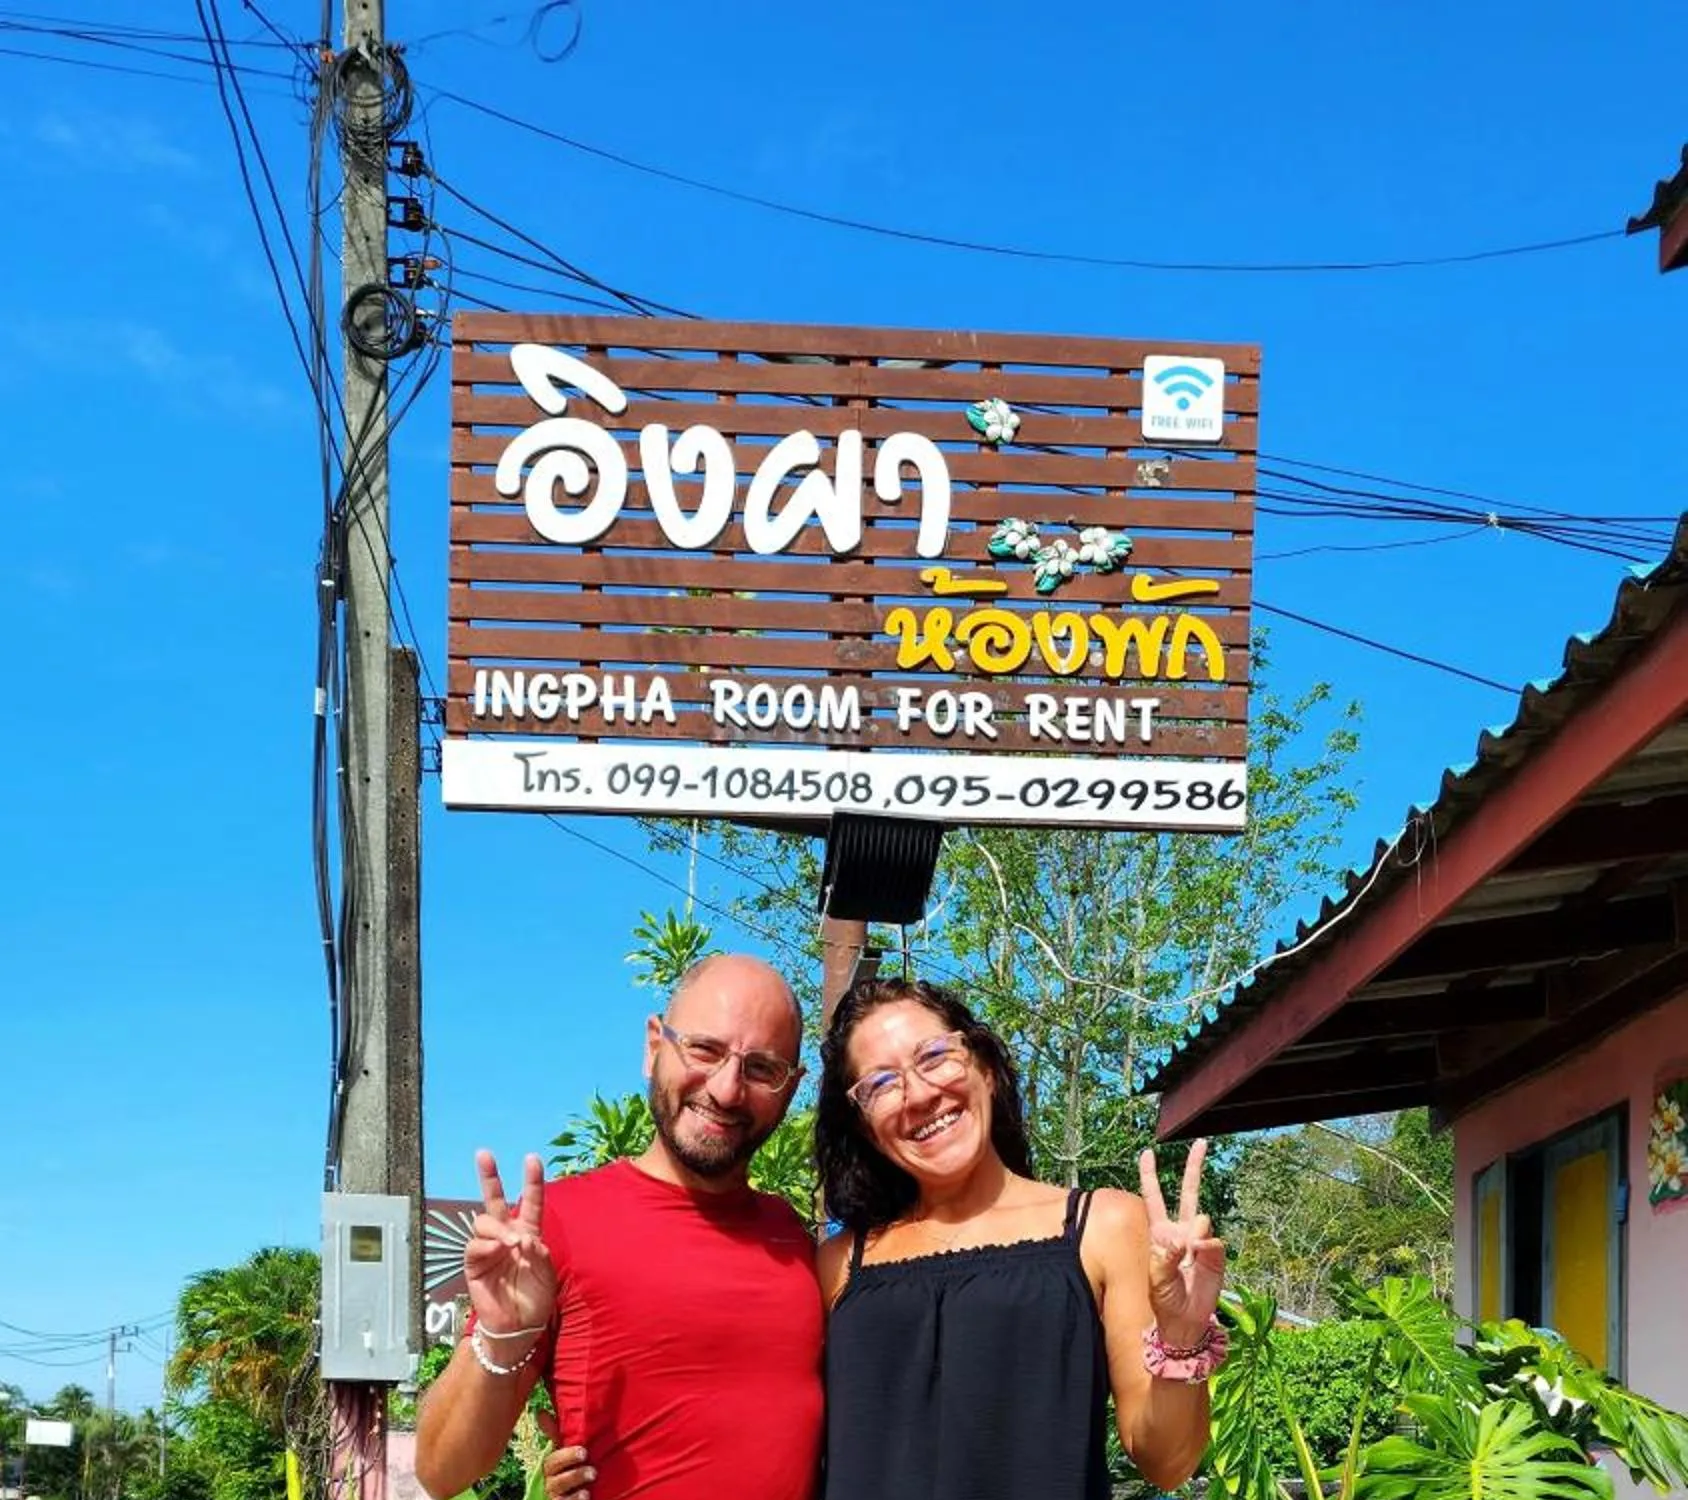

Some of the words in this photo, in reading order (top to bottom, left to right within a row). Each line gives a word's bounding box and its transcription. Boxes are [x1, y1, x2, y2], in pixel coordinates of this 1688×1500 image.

[495, 343, 951, 559] อิงผา
[1151, 414, 1180, 429] FREE
[884, 567, 1225, 681] ห้องพัก
[474, 669, 677, 724] INGPHA
[709, 679, 861, 731] ROOM
[897, 687, 998, 739] FOR
[1024, 693, 1160, 744] RENT
[513, 750, 592, 796] โทร.
